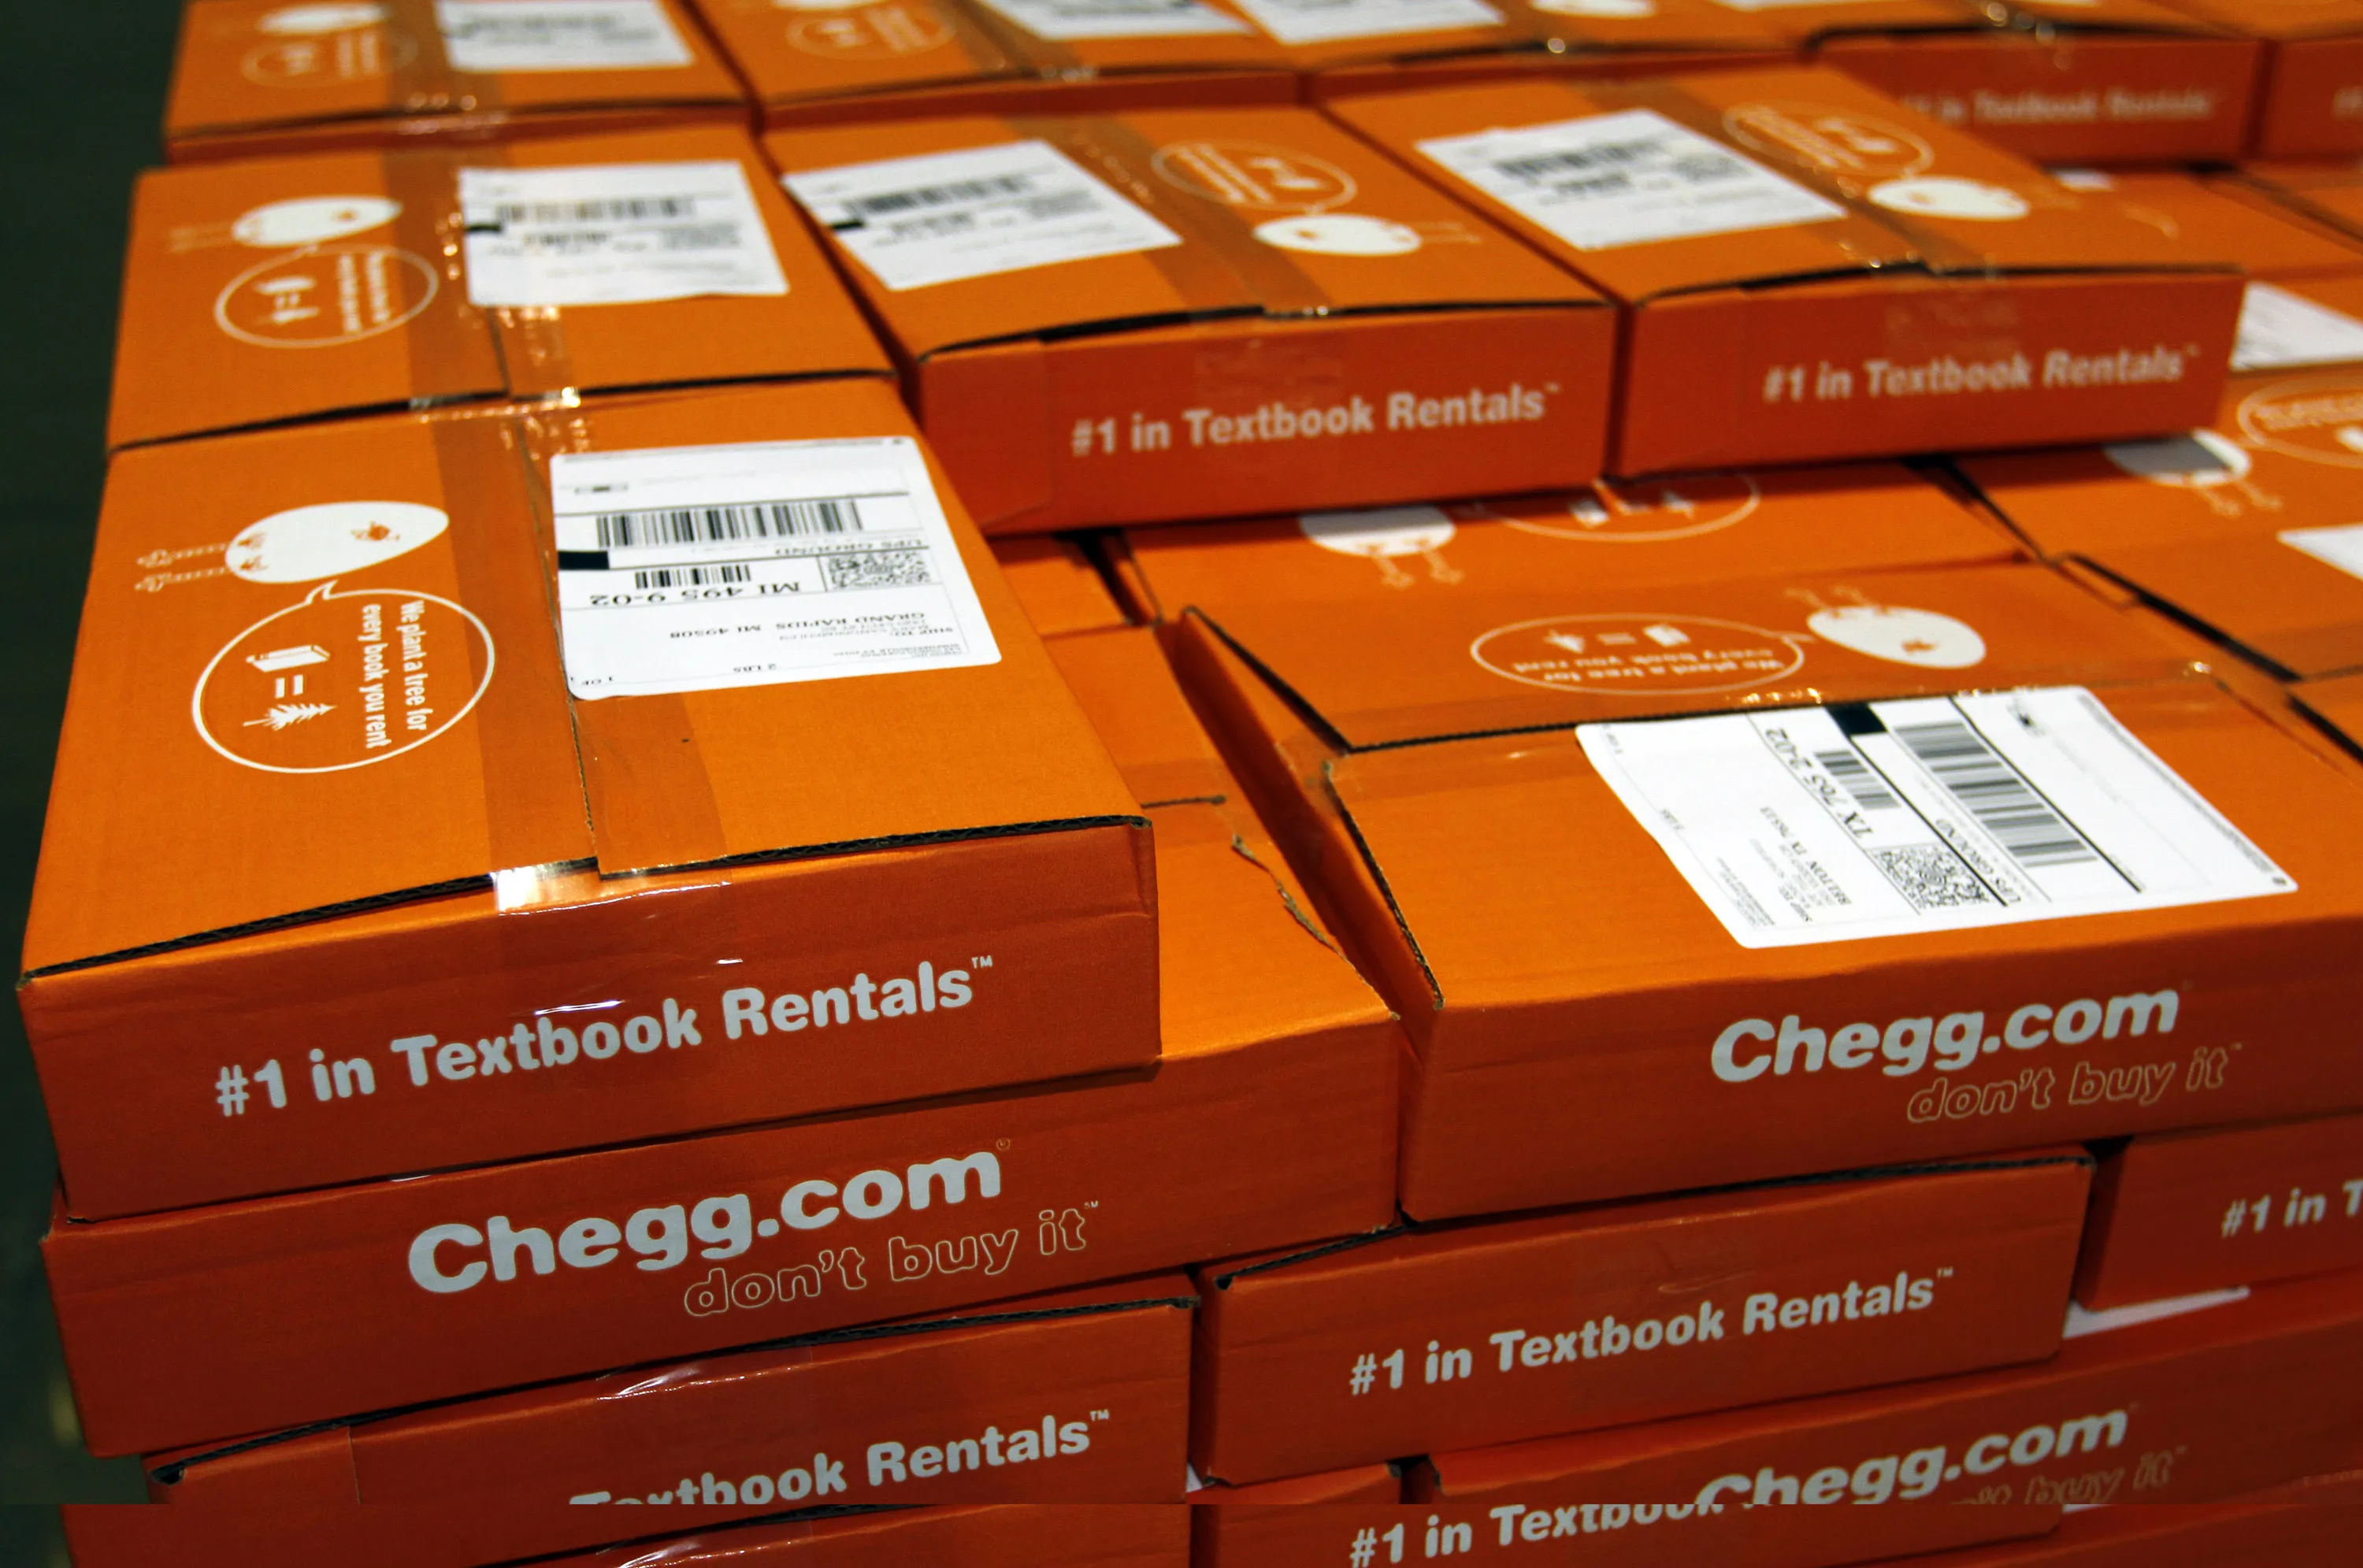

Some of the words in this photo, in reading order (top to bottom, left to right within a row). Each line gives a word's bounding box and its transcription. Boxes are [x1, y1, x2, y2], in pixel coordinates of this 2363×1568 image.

[1816, 361, 1853, 398] in
[1866, 353, 2031, 395] Textbook
[1072, 417, 1116, 454] #1
[1131, 413, 1170, 450] in
[1182, 396, 1374, 444] Textbook
[590, 592, 666, 606] 9-02
[681, 586, 744, 600] 495
[757, 581, 801, 595] MI
[358, 604, 382, 642] every
[400, 599, 425, 623] We
[395, 624, 427, 661] plant
[363, 643, 390, 682] book
[403, 661, 424, 673] a
[359, 683, 385, 713] you
[404, 673, 428, 706] tree
[365, 714, 392, 749] rent
[406, 708, 434, 731] for
[1710, 988, 2180, 1083] Chegg.com
[213, 1058, 287, 1118] #1
[308, 1047, 377, 1103] in
[389, 997, 703, 1088] Textbook
[2068, 1060, 2178, 1106] buy
[2220, 1195, 2271, 1238] #1
[2283, 1186, 2327, 1228] in
[887, 1228, 1020, 1282] buy
[1348, 1347, 1405, 1396] #1
[1424, 1340, 1473, 1385] in
[1488, 1300, 1726, 1373] Textbook
[1348, 1522, 1405, 1568] #1
[1424, 1514, 1474, 1559] in
